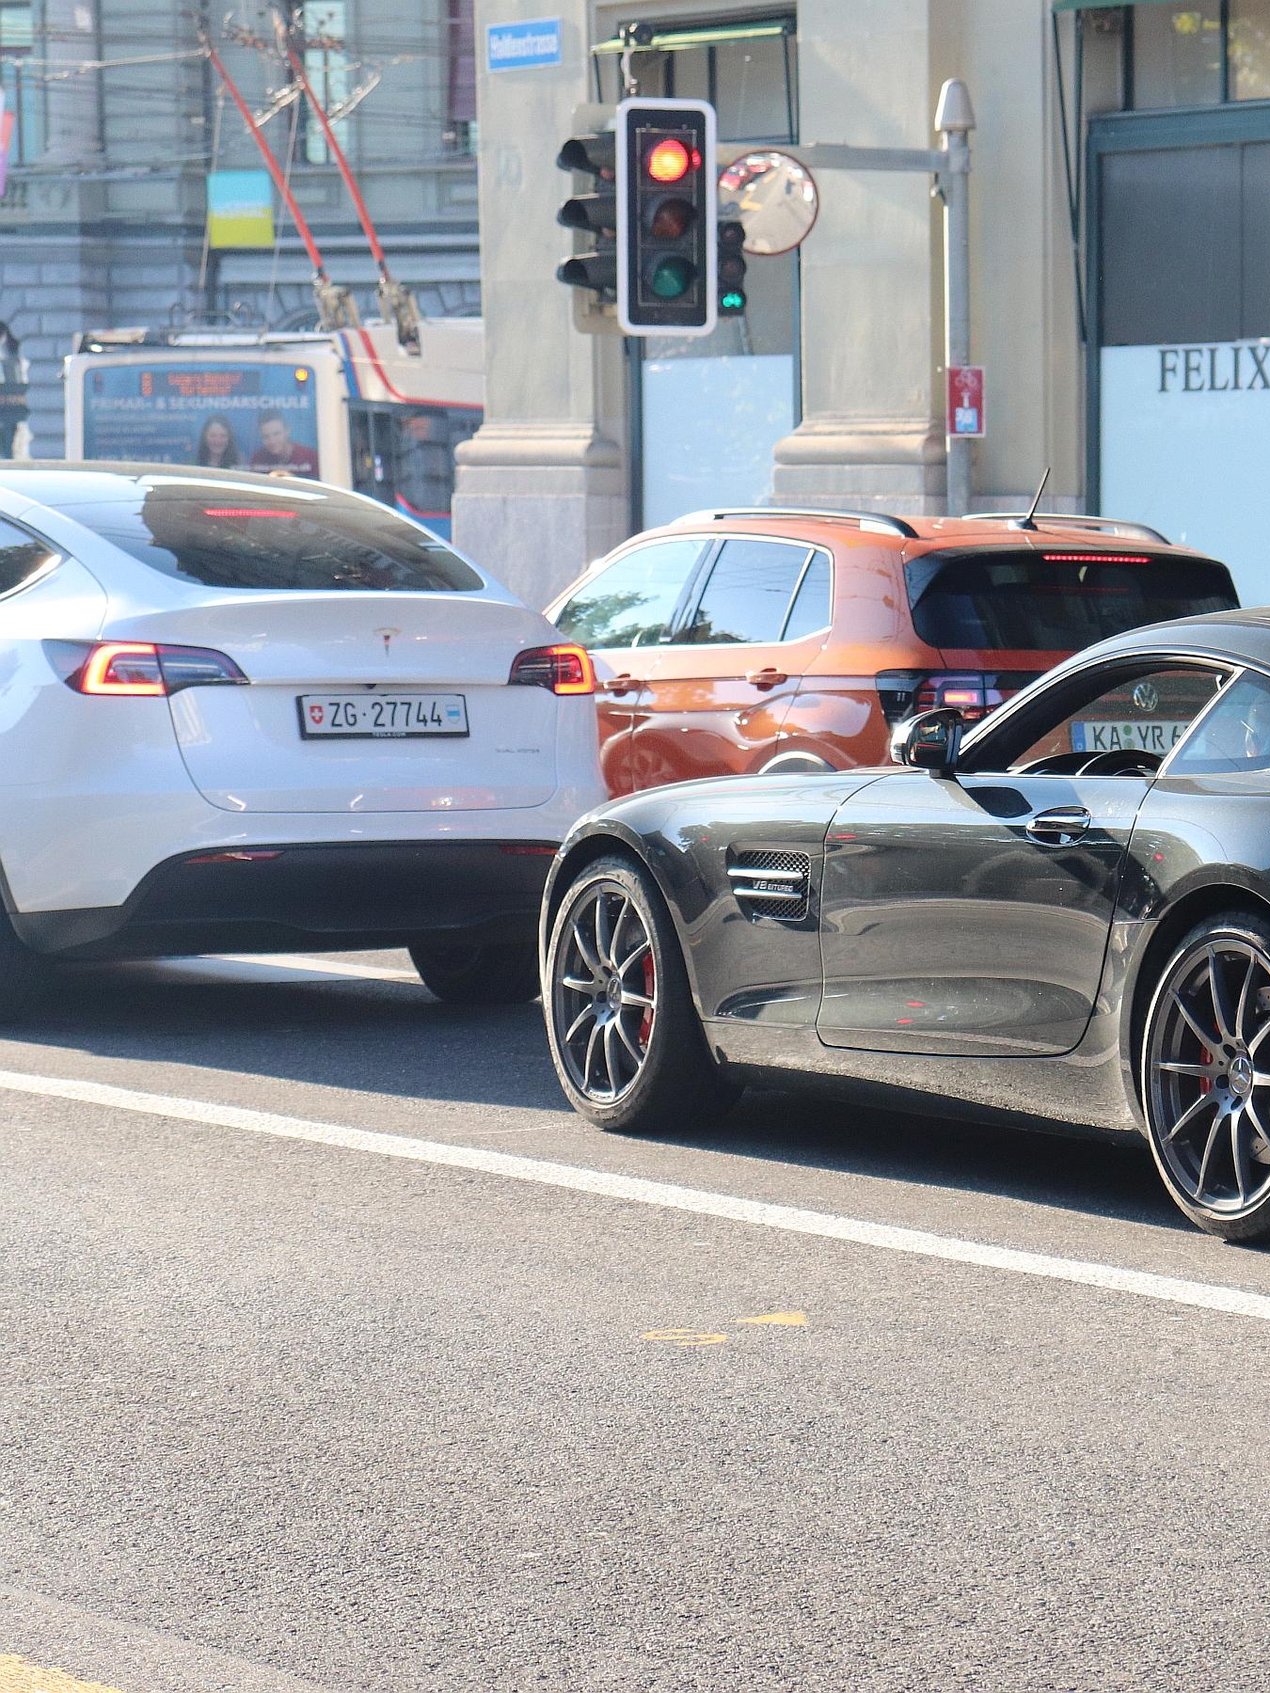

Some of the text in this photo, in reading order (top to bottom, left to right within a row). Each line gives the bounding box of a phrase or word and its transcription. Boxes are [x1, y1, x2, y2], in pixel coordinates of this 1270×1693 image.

[1093, 726, 1122, 750] KA
[1137, 725, 1165, 750] YR
[753, 880, 767, 890] V8
